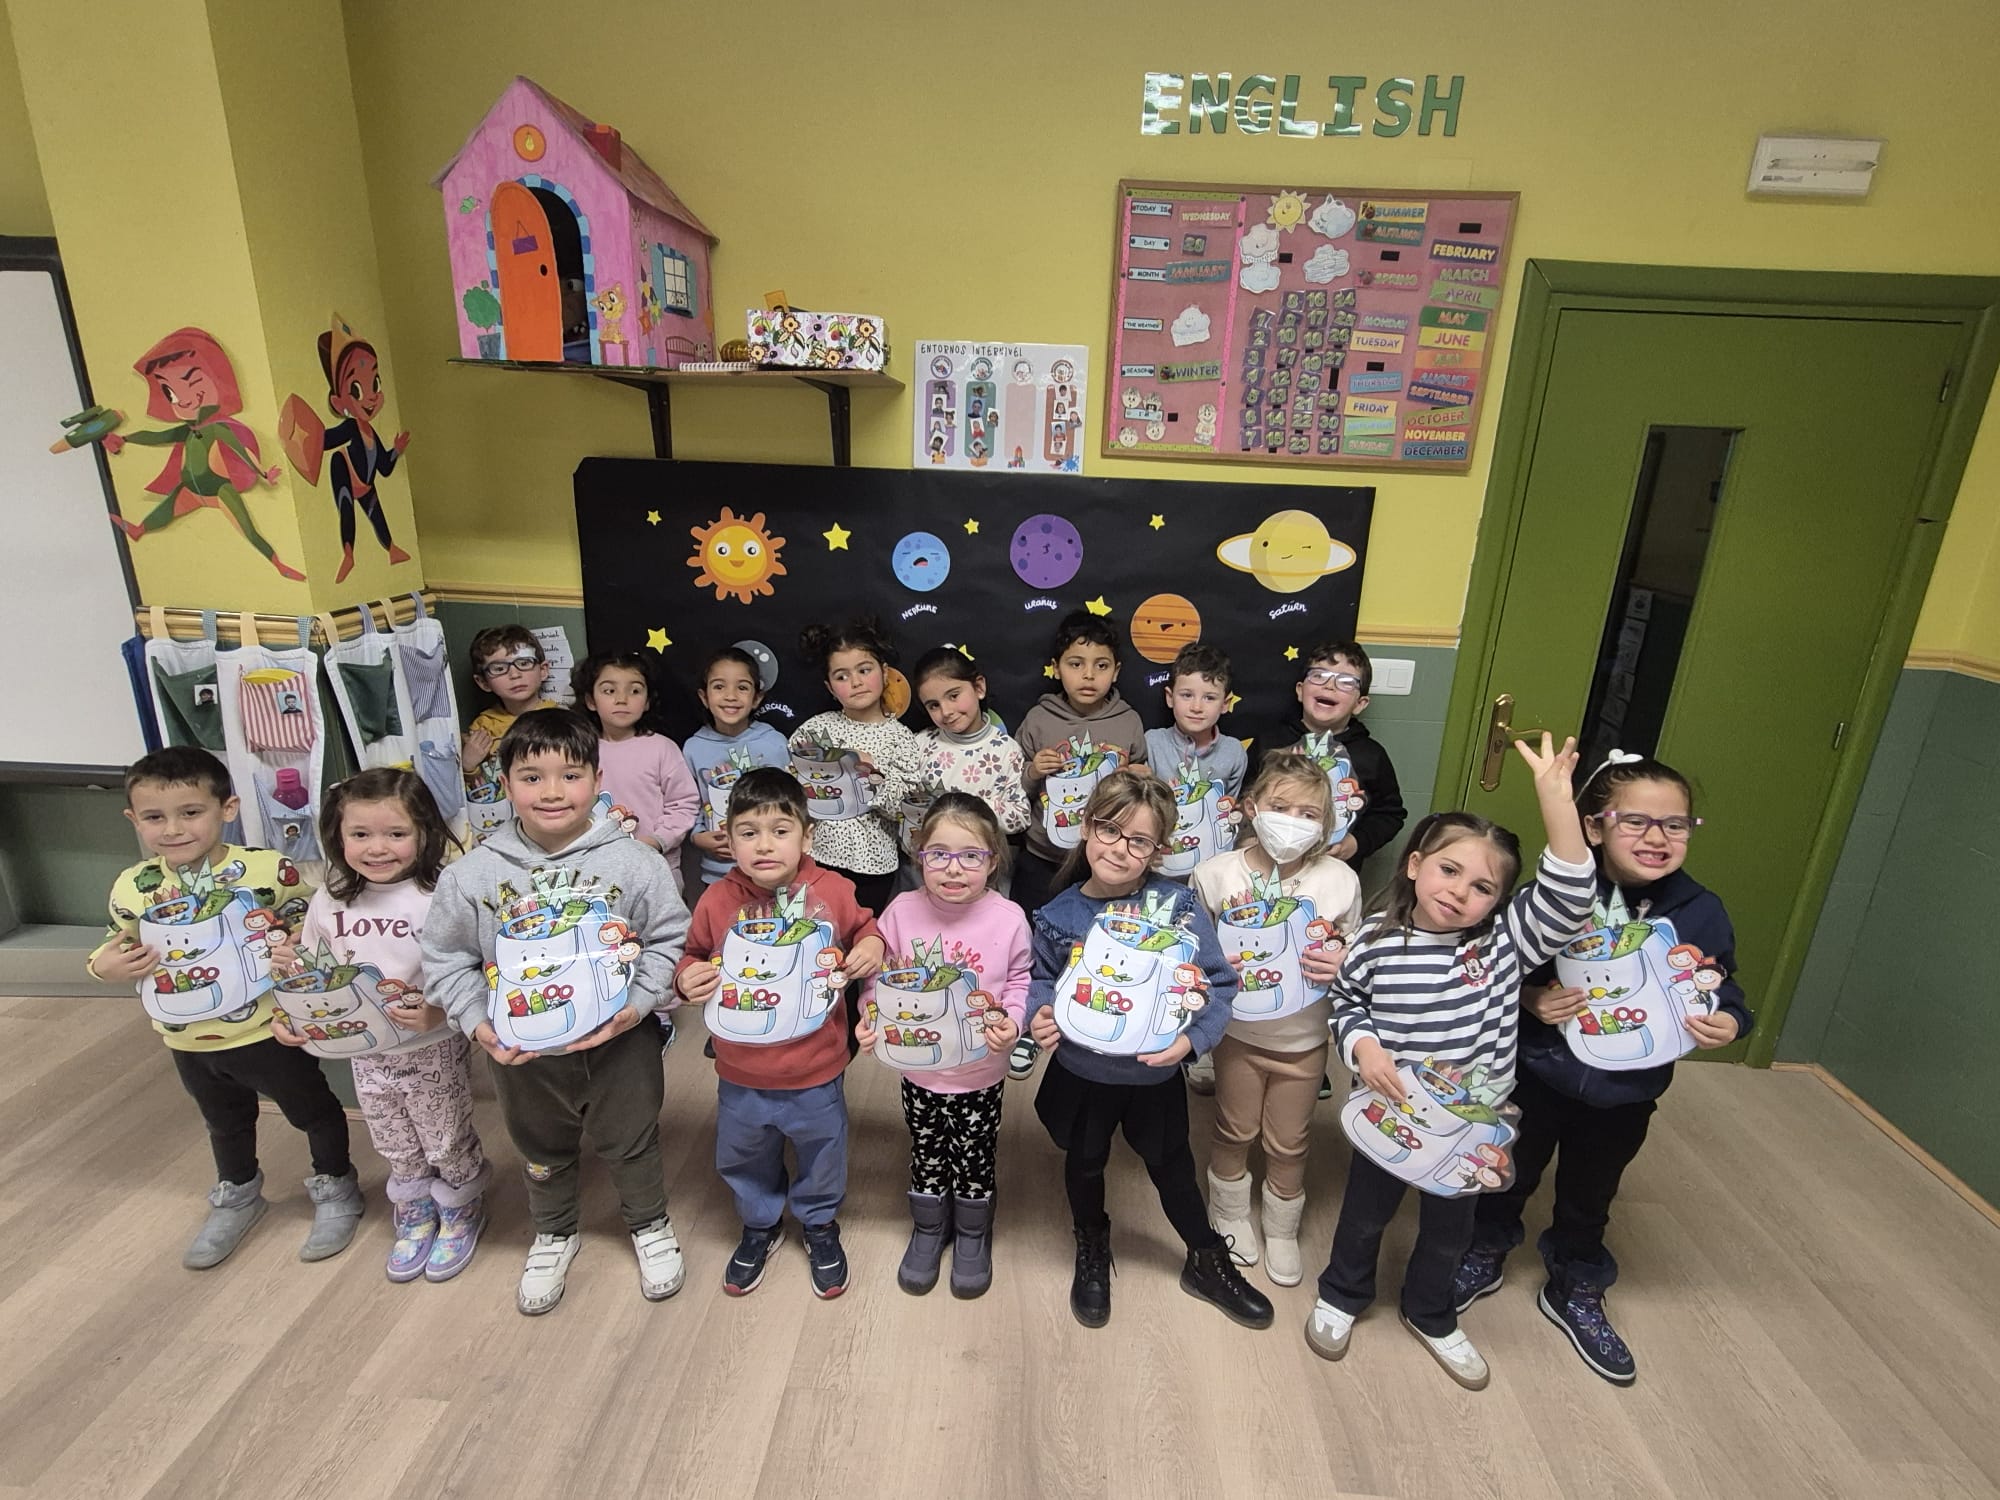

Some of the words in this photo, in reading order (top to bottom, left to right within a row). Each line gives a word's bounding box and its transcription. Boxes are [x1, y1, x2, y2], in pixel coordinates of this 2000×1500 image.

[1141, 72, 1465, 139] ENGLISH
[1135, 204, 1156, 212] TODAY
[1374, 207, 1425, 218] SUMMER
[1182, 212, 1231, 221] WEDNESDAY
[1433, 244, 1496, 261] FEBRUARY
[1170, 265, 1226, 278] JANUARY
[1374, 273, 1417, 285] SPRING
[1440, 268, 1489, 281] MARCH
[1286, 293, 1298, 309] 8
[1307, 292, 1325, 307] 16
[1446, 289, 1482, 304] APRIL
[1307, 309, 1327, 325] 17
[1363, 315, 1408, 329] MONDAY
[1438, 311, 1469, 325] MAY
[1253, 331, 1265, 346] 2
[1277, 328, 1296, 343] 10
[1328, 328, 1350, 342] 26
[1355, 336, 1400, 348] TUESDAY
[1434, 333, 1471, 347] JUNE
[921, 344, 967, 355] ENTORNOS
[1279, 348, 1297, 365] 11
[1248, 350, 1259, 365] 3
[1302, 355, 1321, 371] 19
[1325, 351, 1345, 365] 27
[1175, 365, 1219, 377] WINTER
[1247, 368, 1258, 383] 4
[1271, 370, 1290, 386] 12
[1297, 373, 1320, 390] 20
[1353, 376, 1399, 387] THURSDAY
[1268, 387, 1287, 404] 13
[1319, 392, 1339, 407] 29
[1410, 386, 1470, 404] SEPTEMBER
[1294, 396, 1314, 411] 21
[1353, 402, 1389, 413] FRIDAY
[1245, 409, 1256, 424] 6
[1266, 411, 1285, 426] 14
[1292, 413, 1312, 428] 22
[1319, 415, 1339, 431] 30
[1408, 411, 1464, 426] OCTOBER
[1245, 430, 1256, 445] 7
[1266, 431, 1284, 446] 15
[1405, 430, 1466, 441] NOVEMBER
[1289, 436, 1310, 451] 23
[1320, 436, 1337, 451] 31
[1404, 446, 1464, 456] DECEMBER
